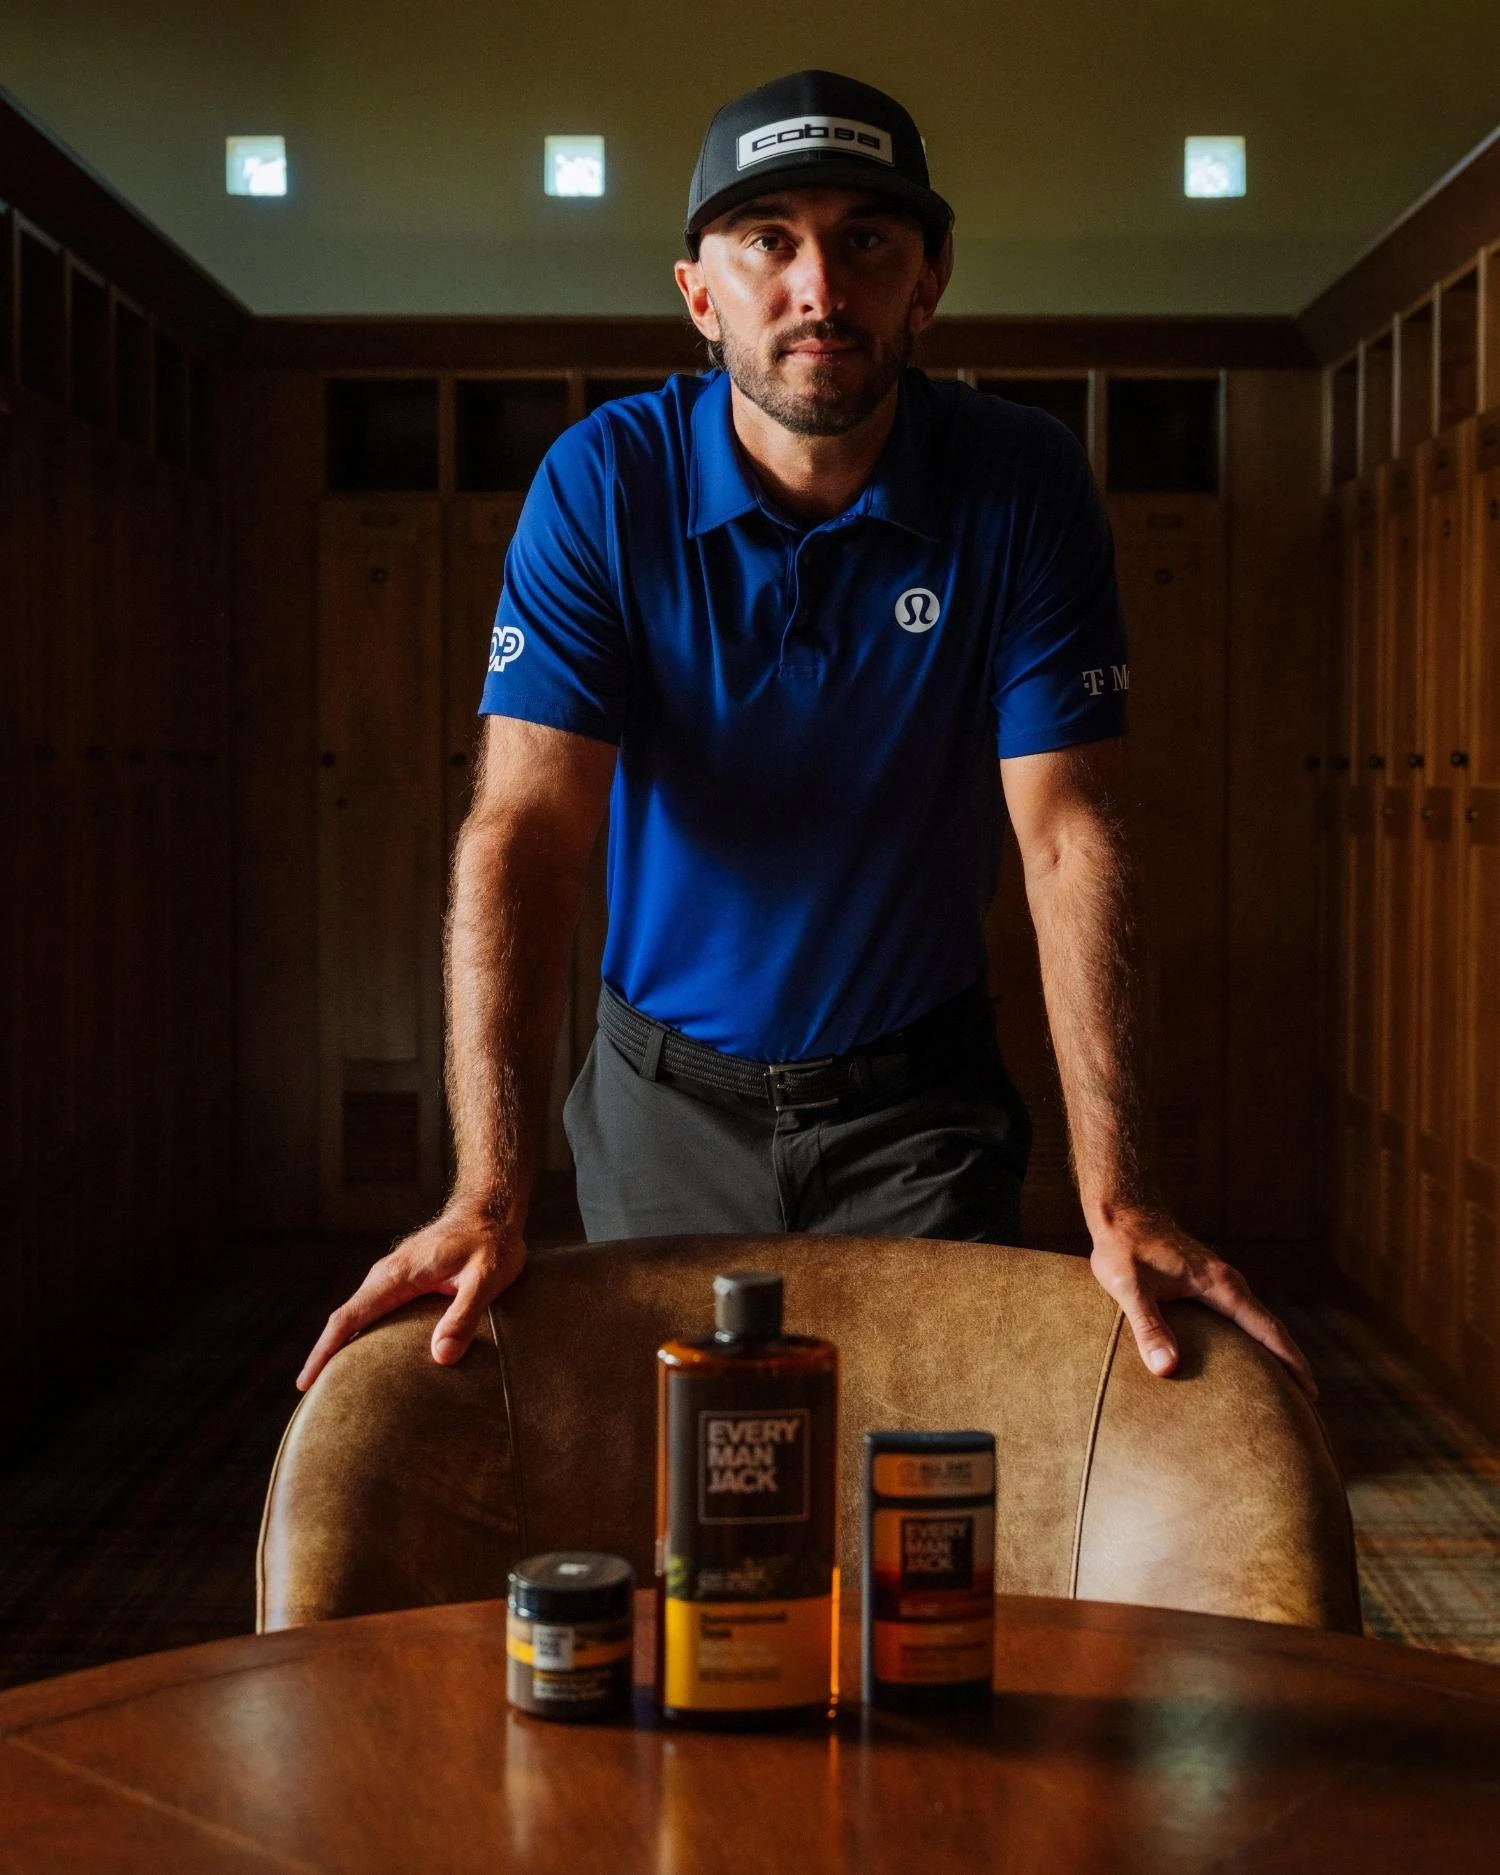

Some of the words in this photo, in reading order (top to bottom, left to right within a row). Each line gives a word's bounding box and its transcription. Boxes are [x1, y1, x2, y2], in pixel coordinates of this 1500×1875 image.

[708, 1418, 801, 1445] EVERY
[708, 1444, 775, 1468] MAN
[707, 1469, 780, 1494] JACK
